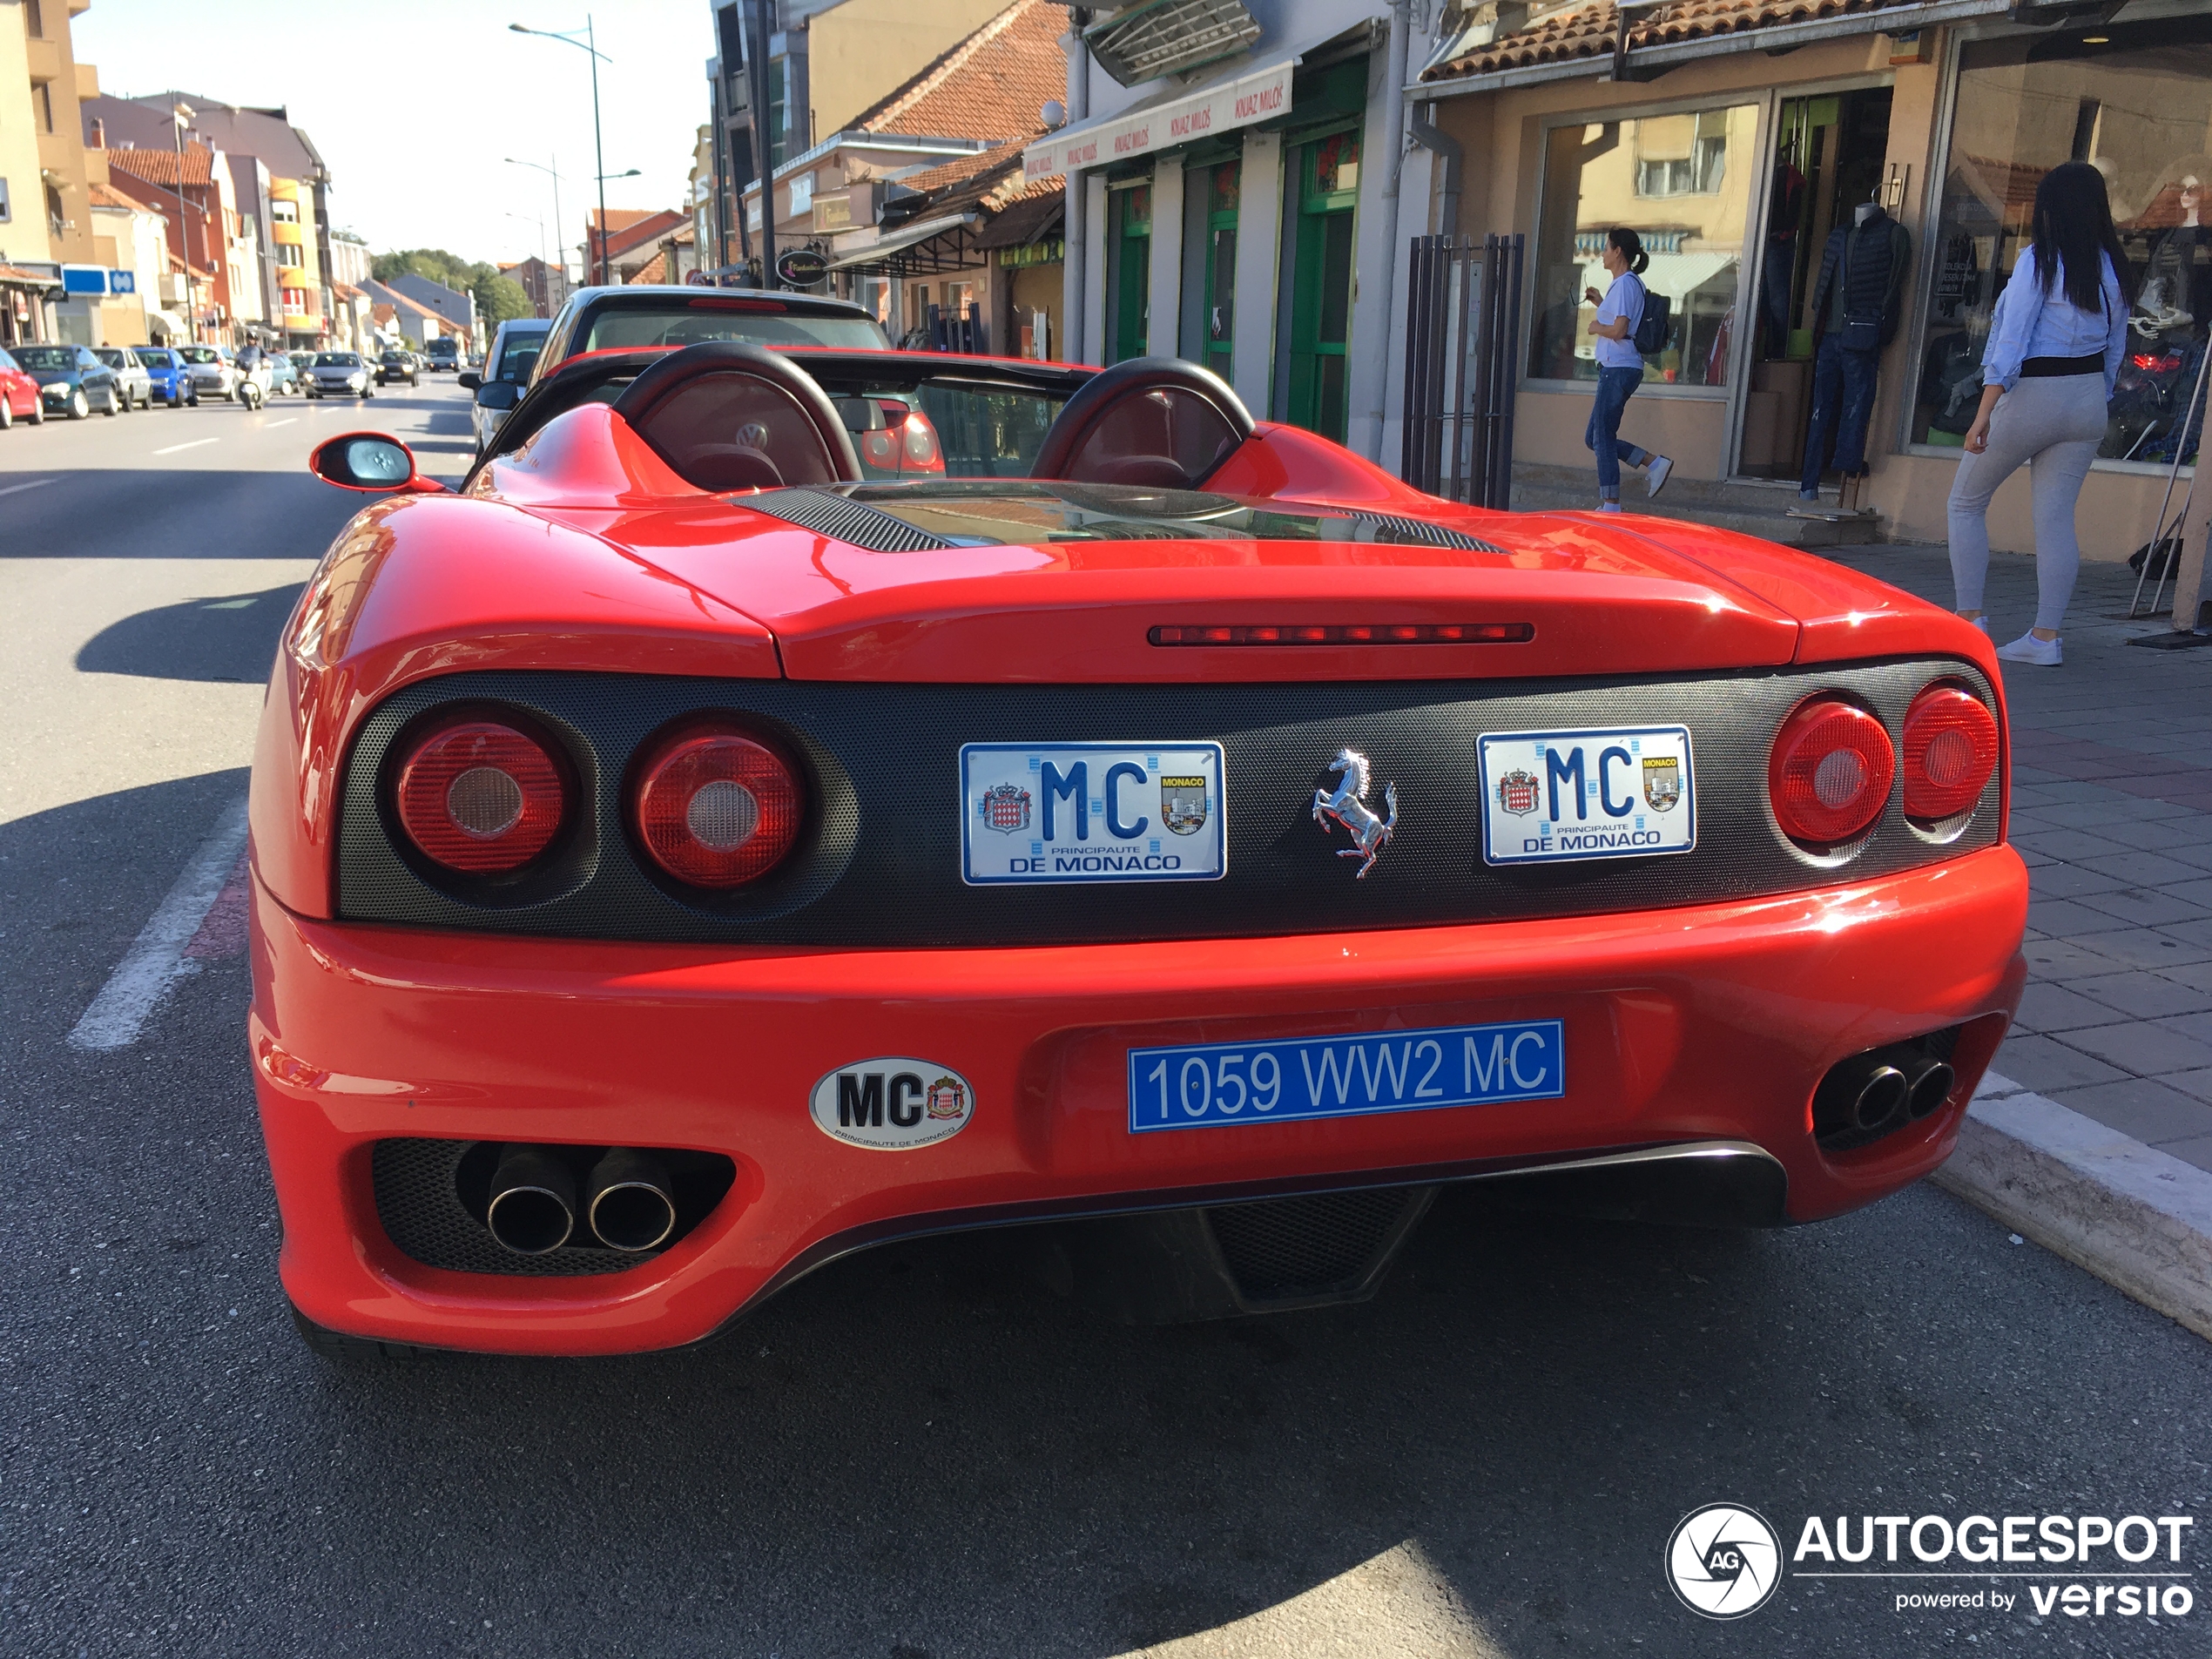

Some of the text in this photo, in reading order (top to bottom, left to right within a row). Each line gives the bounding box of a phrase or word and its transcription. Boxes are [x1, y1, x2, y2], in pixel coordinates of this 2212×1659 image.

[1235, 81, 1283, 118] KNJAZ MILOŠ
[1643, 759, 1676, 767] MONACO
[1163, 778, 1204, 786] MONACO
[1546, 746, 1635, 821] MC
[1042, 760, 1149, 841] MC
[1557, 824, 1629, 834] PRINCIPAUTE
[1523, 831, 1661, 853] DE MONACO
[1010, 855, 1181, 873] DE MONACO
[1149, 1032, 1547, 1119] 1059 WW2 MC
[837, 1072, 924, 1129] MC
[835, 1130, 895, 1146] PRINCIPAUTE
[914, 1127, 954, 1143] MONACO
